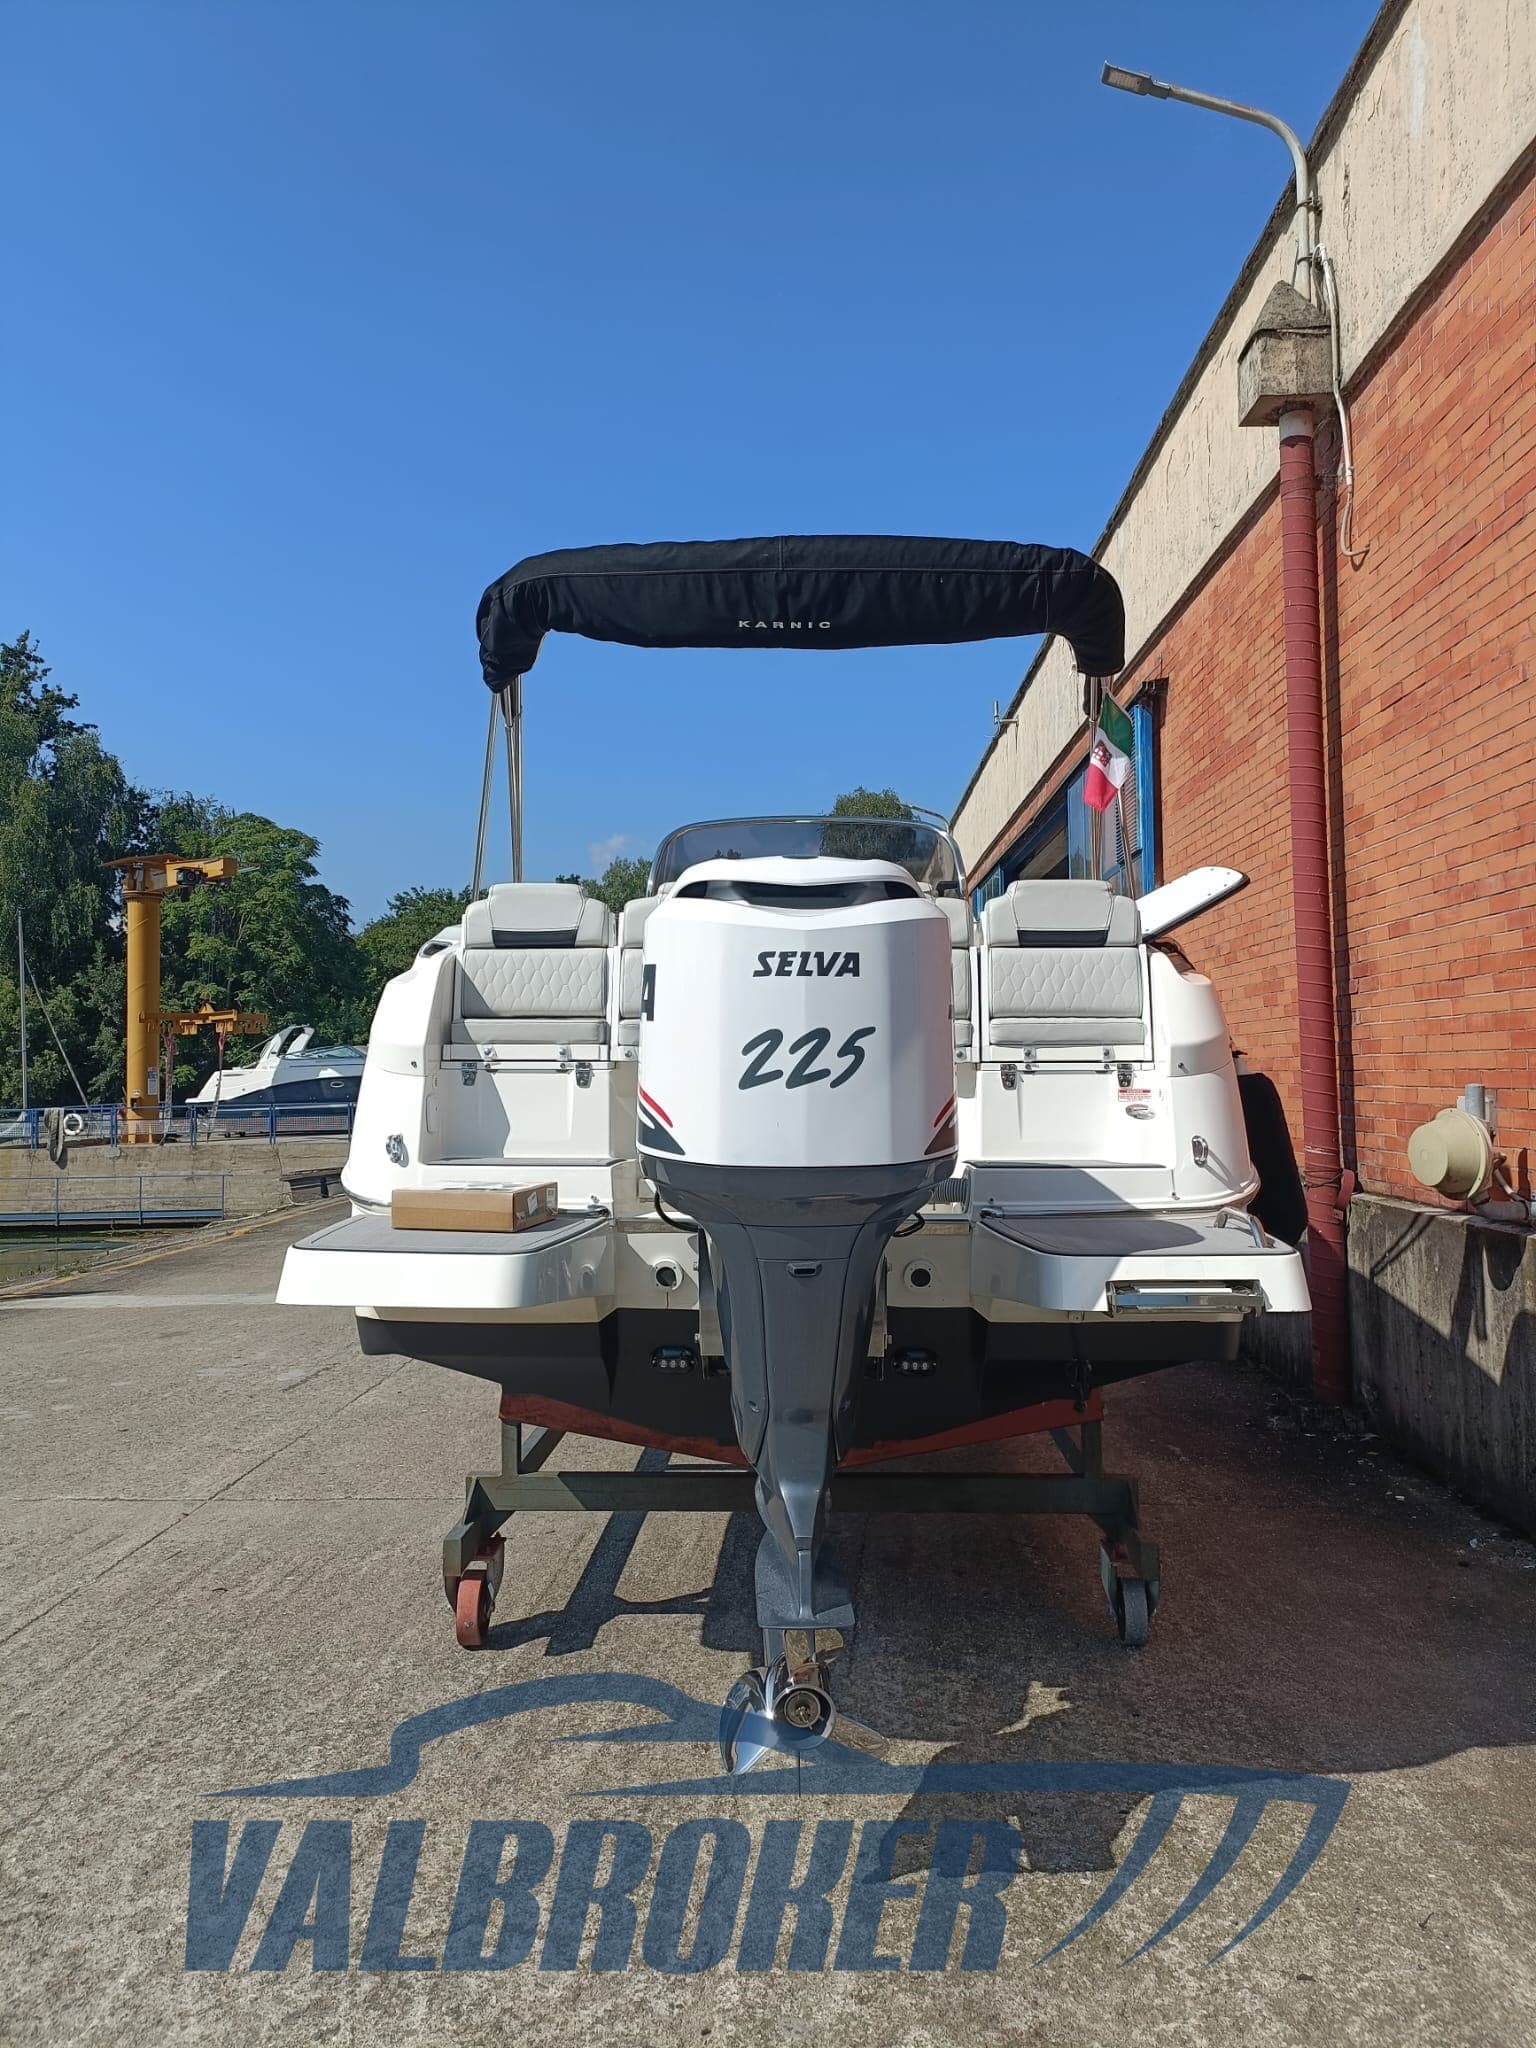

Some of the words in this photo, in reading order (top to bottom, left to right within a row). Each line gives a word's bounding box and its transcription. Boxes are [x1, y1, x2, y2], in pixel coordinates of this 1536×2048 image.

[738, 620, 832, 629] KARNIC
[753, 951, 861, 978] SELVA
[738, 1026, 877, 1091] 225
